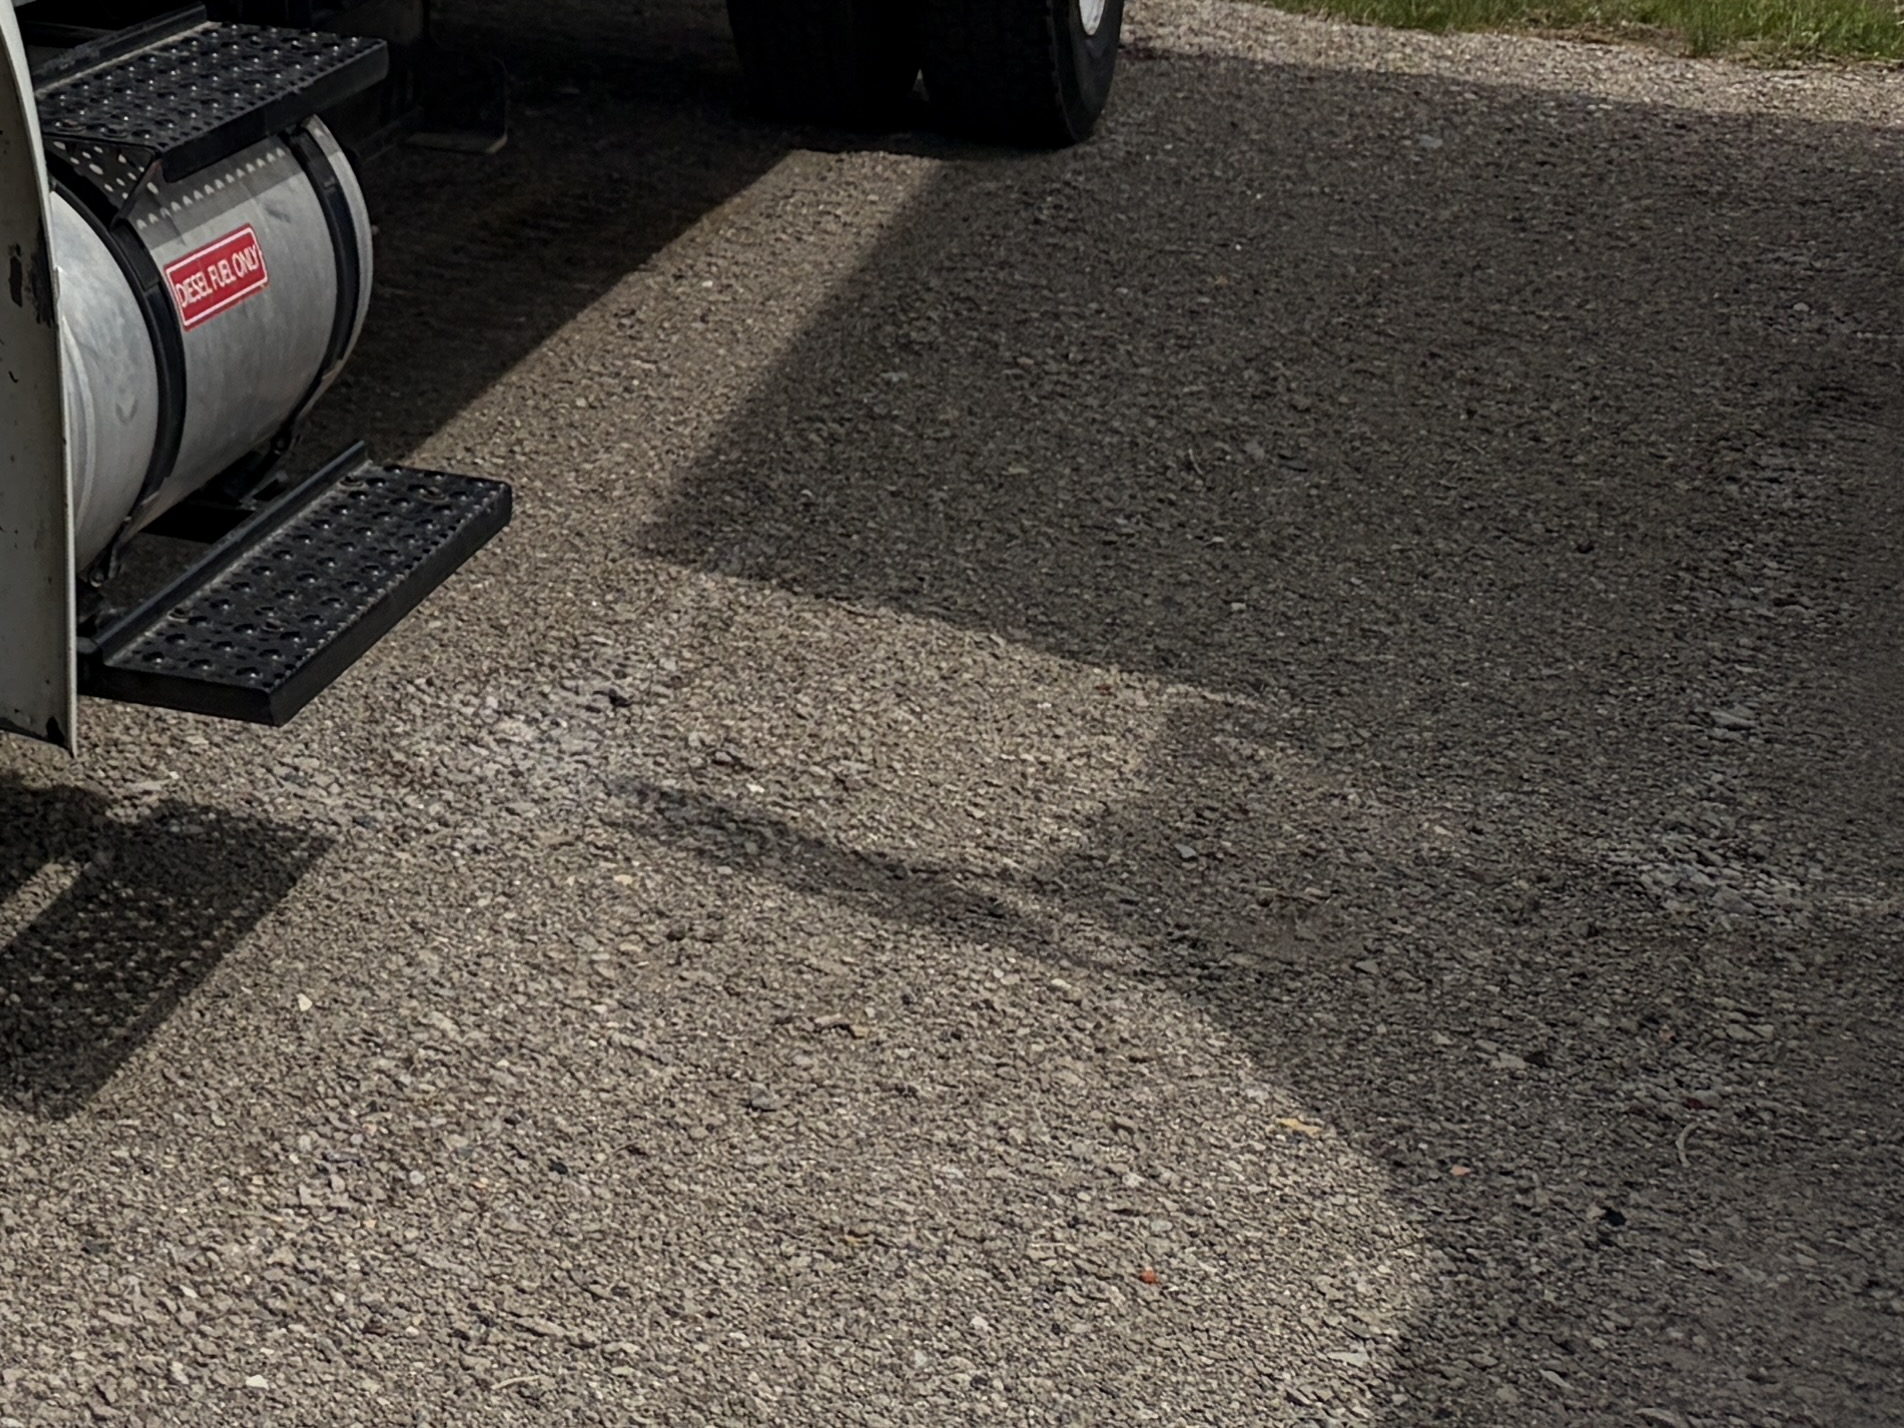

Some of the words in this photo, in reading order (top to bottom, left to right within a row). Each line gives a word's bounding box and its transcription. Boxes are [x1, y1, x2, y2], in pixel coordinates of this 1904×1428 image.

[175, 271, 213, 308] DIESEL
[207, 258, 237, 291] FUEL
[232, 244, 259, 278] ONLY
